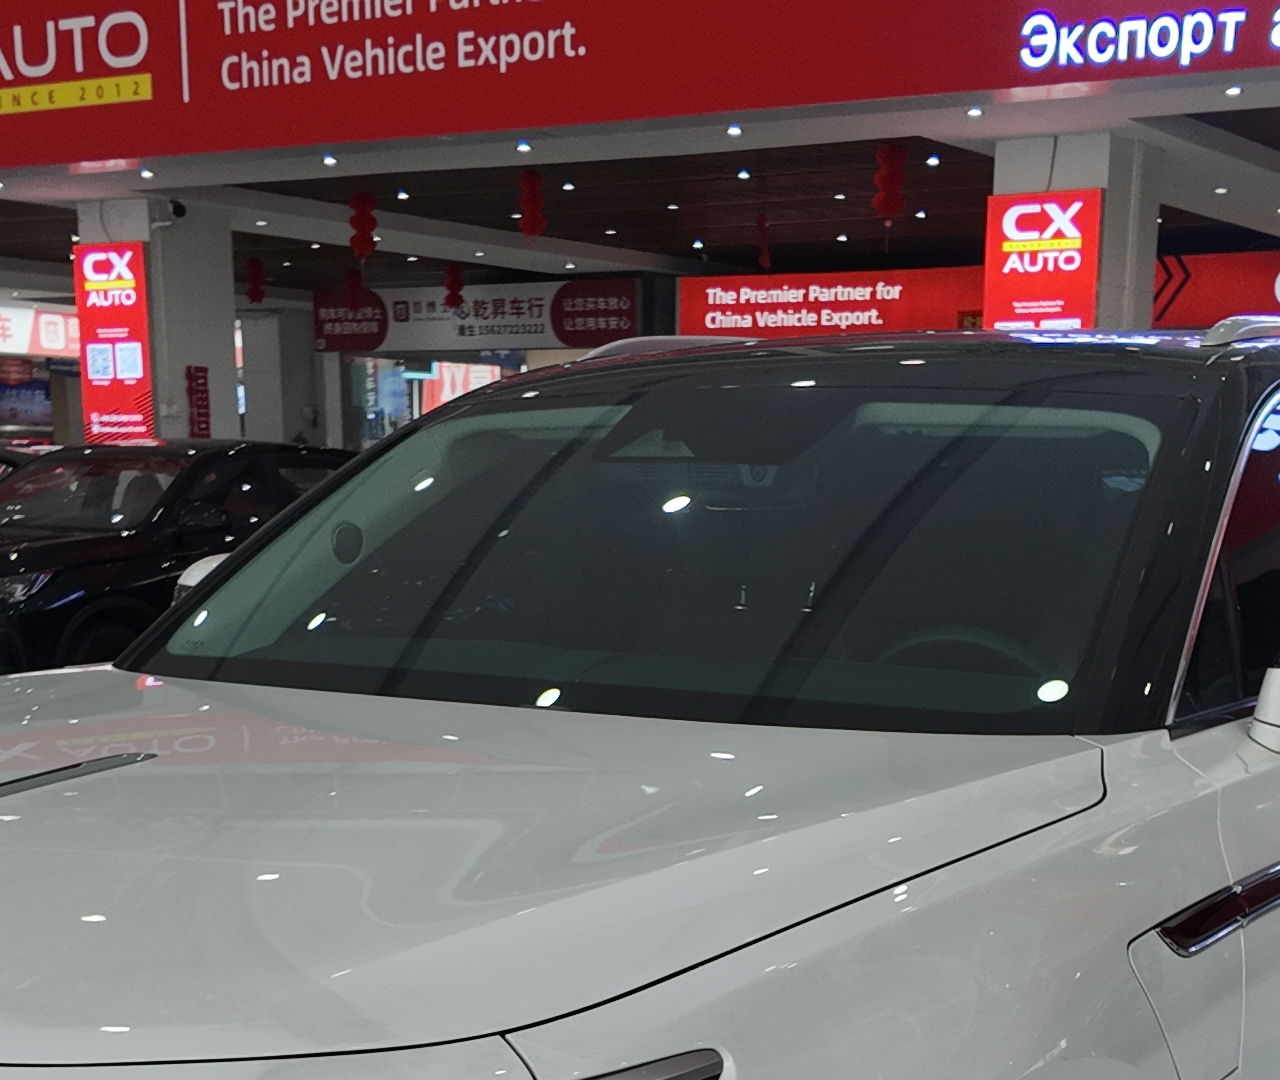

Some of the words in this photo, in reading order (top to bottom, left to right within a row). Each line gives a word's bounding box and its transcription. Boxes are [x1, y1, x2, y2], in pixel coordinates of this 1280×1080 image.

[218, 1, 277, 36] The
[286, 0, 414, 29] Premier
[1020, 9, 1246, 68] Экспорт
[221, 49, 311, 91] China
[321, 33, 446, 81] Vehicle
[457, 21, 586, 73] Export.
[78, 80, 141, 102] 2012
[1002, 201, 1084, 240] CX
[83, 251, 134, 281] CX
[1002, 250, 1081, 274] AUTO
[87, 290, 136, 307] AUTO
[705, 286, 737, 305] The
[740, 284, 806, 304] Premier
[808, 284, 873, 302] Partner
[876, 282, 902, 300] for
[705, 311, 753, 329] China
[756, 309, 818, 328] Vehicle
[821, 308, 883, 329] Export.
